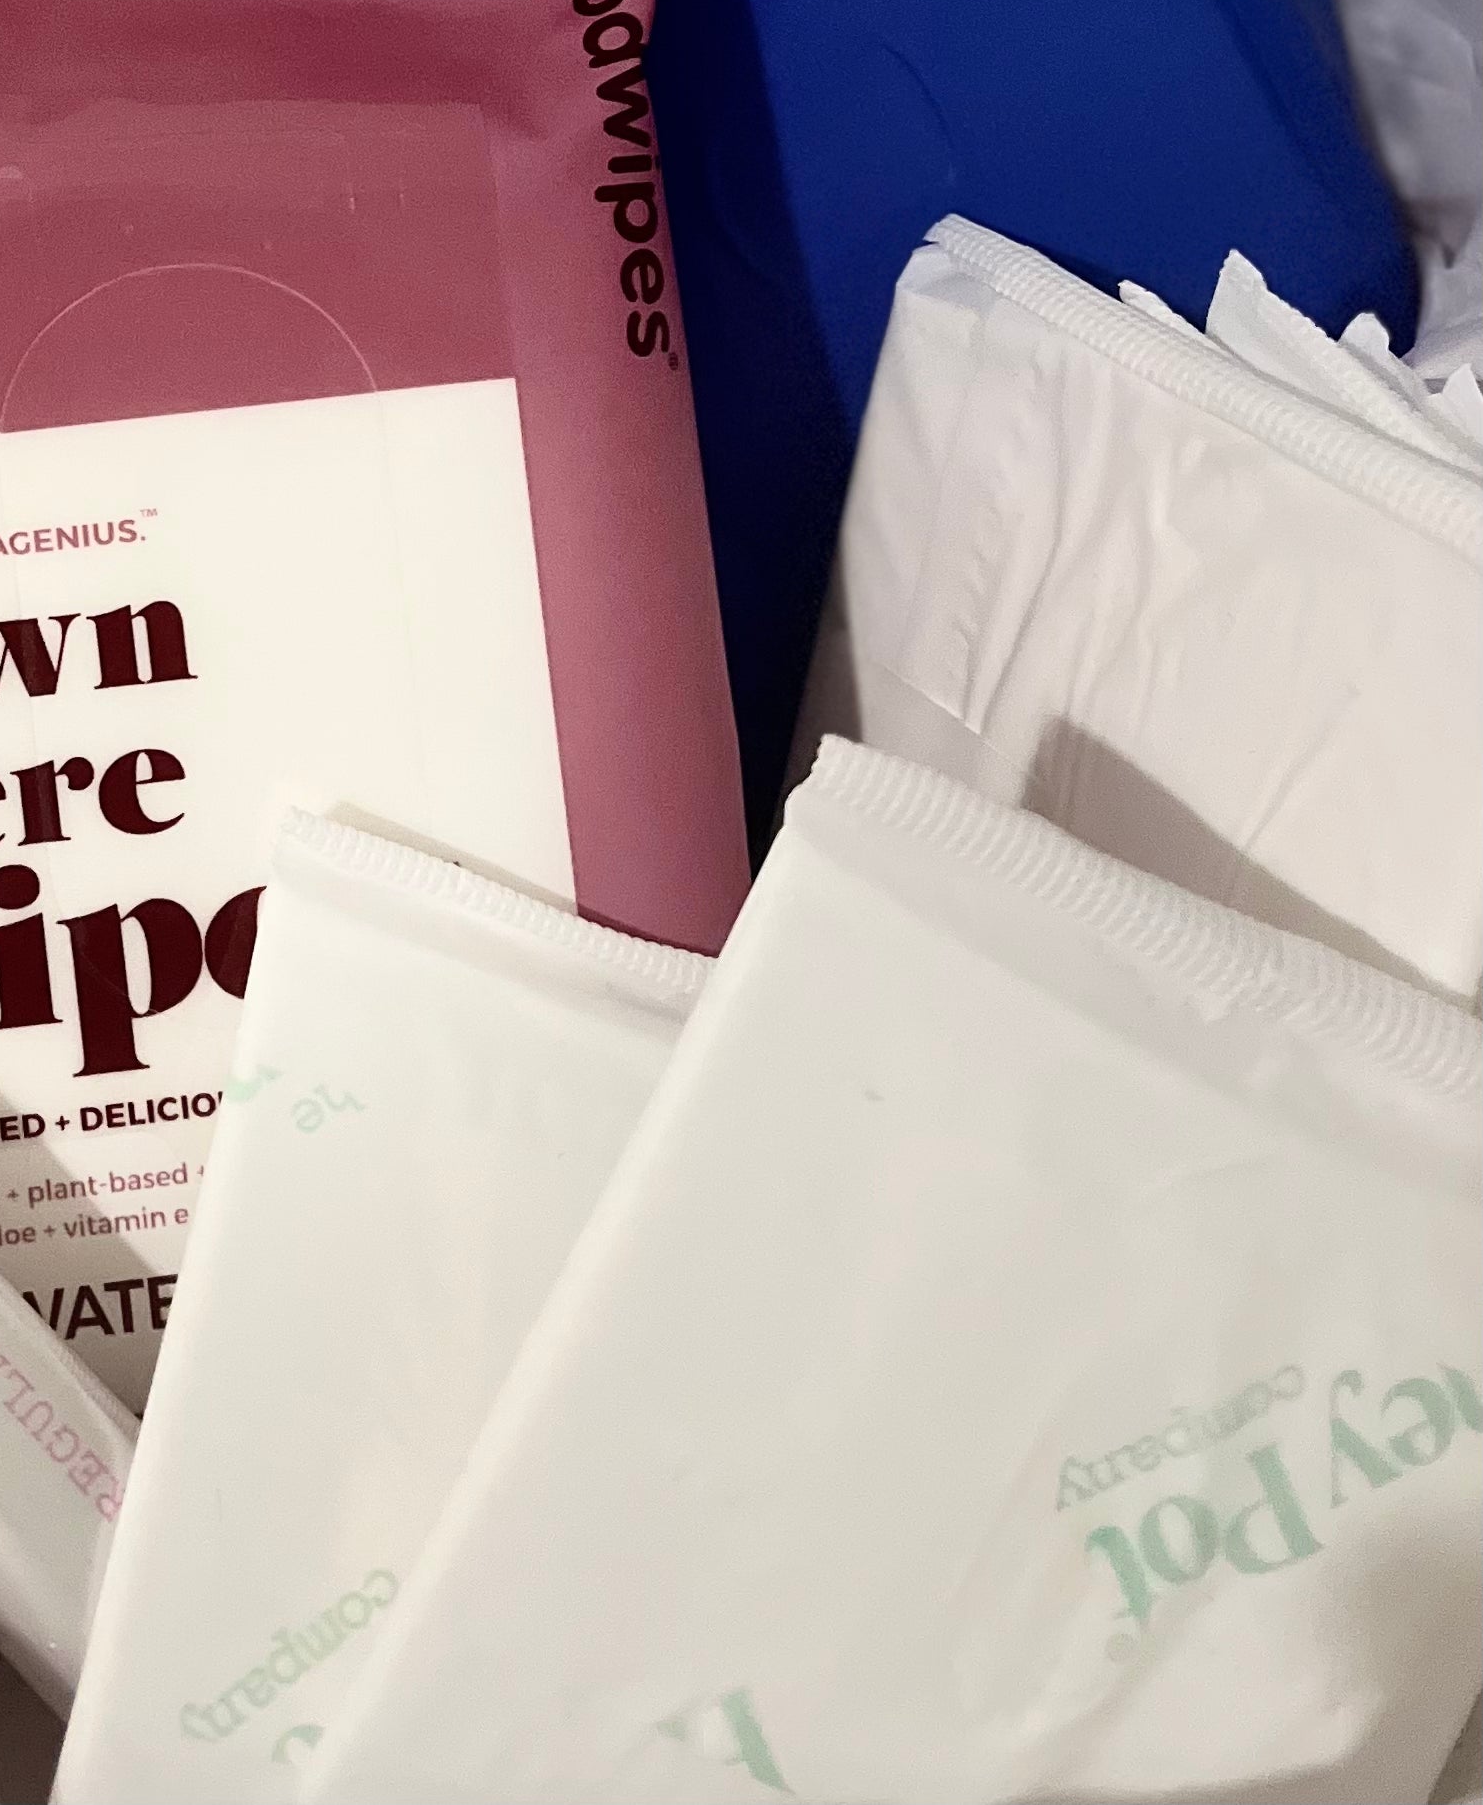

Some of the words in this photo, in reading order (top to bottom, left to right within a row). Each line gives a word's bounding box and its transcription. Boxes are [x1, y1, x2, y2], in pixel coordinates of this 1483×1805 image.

[79, 1090, 225, 1132] DELICIO
[27, 1161, 189, 1210] plant-based
[63, 1206, 167, 1239] vitamin
[174, 1207, 190, 1225] e
